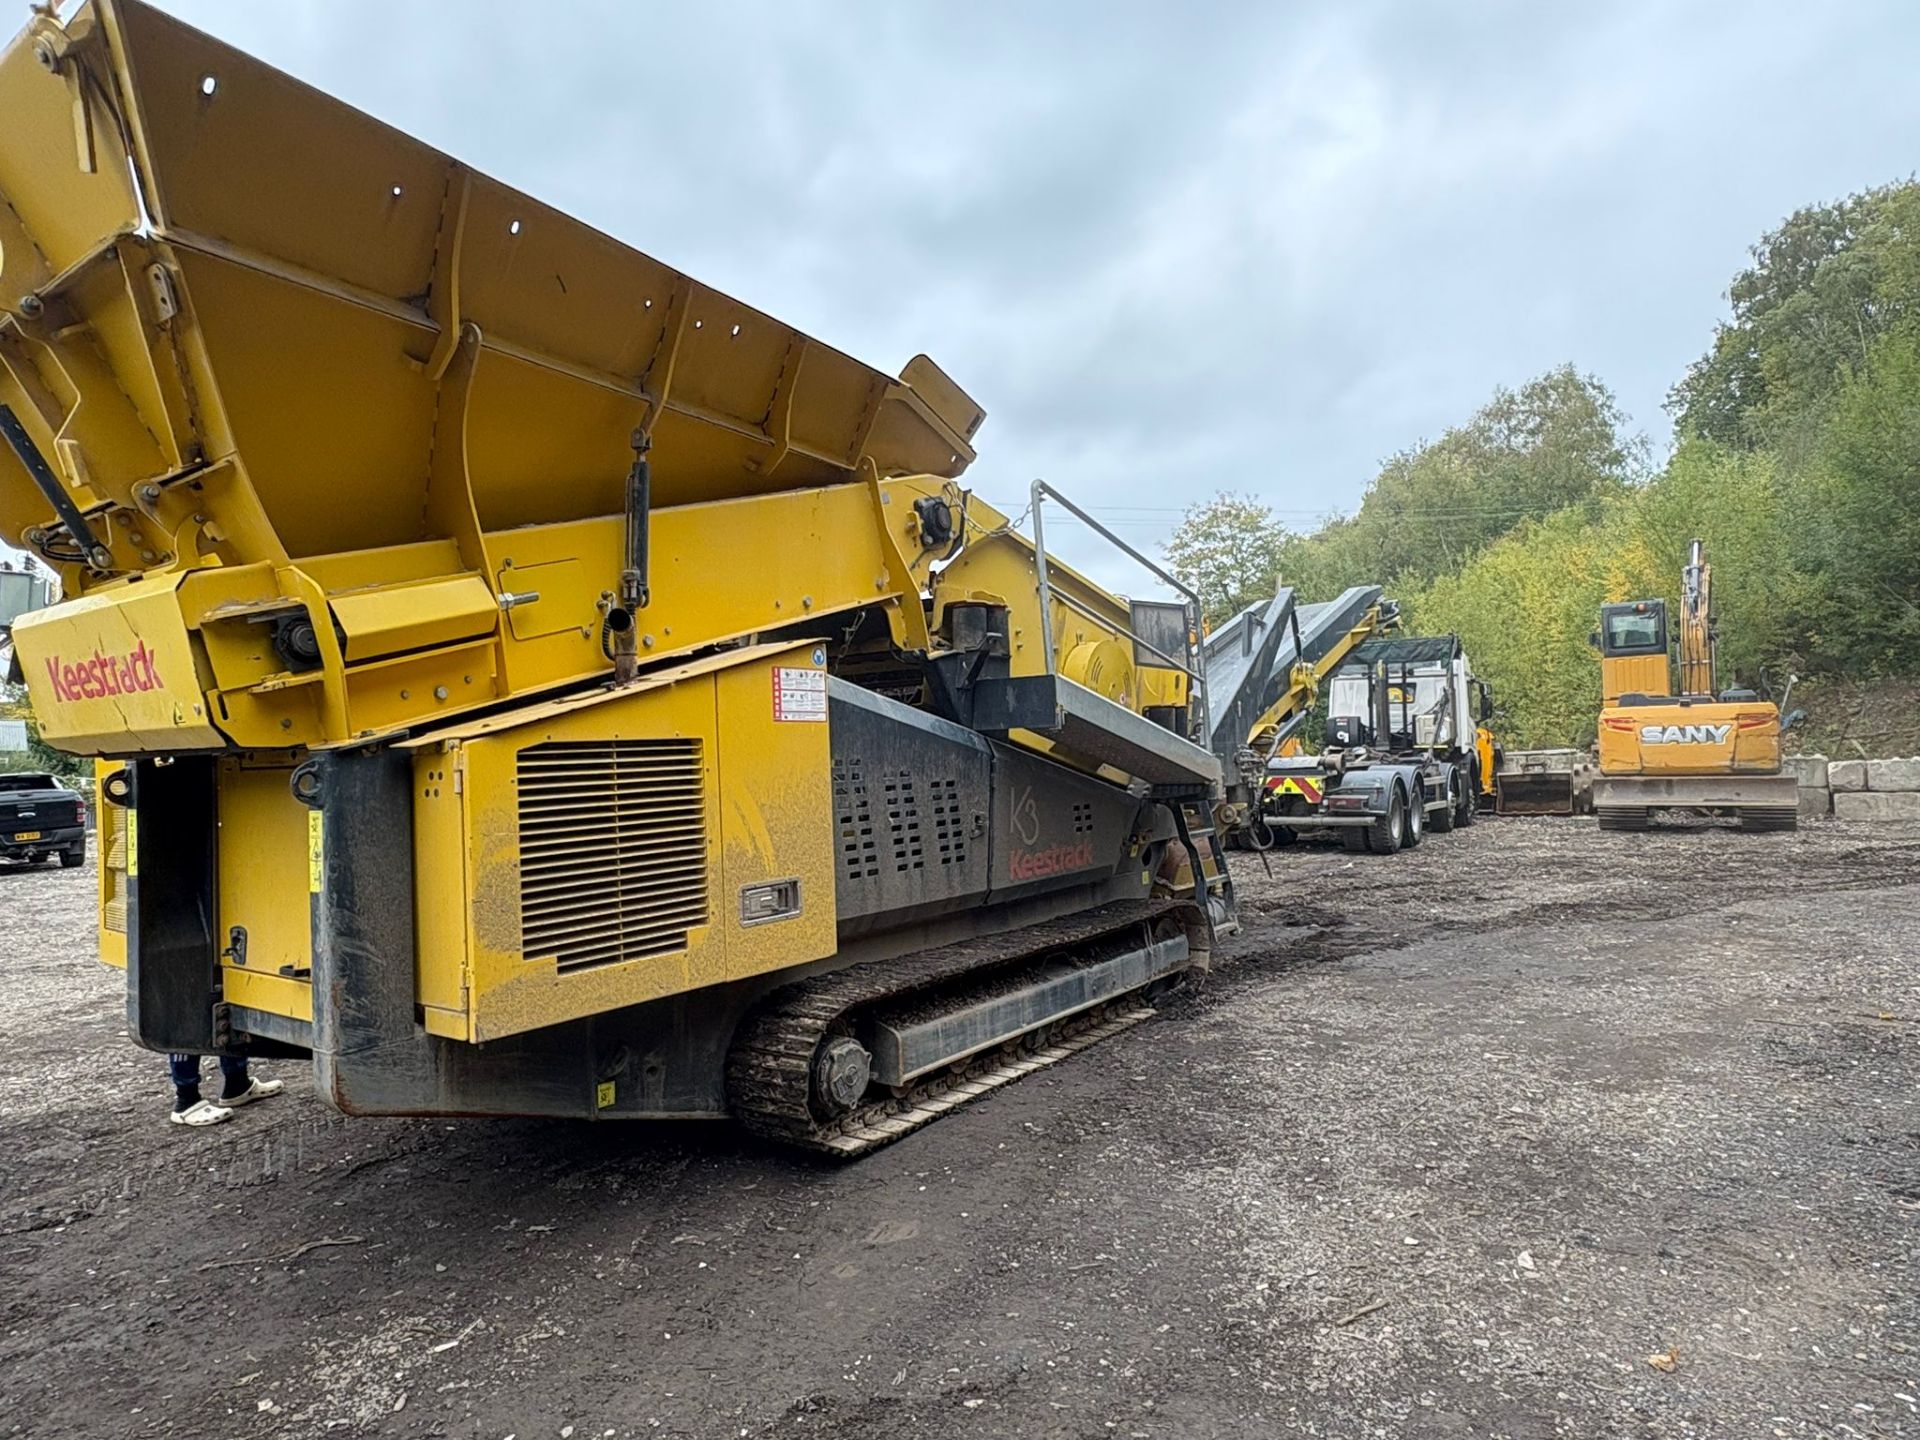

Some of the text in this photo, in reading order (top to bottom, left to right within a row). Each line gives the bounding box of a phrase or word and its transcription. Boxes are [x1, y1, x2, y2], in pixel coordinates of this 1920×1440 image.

[45, 639, 163, 703] Keestrack
[1641, 725, 1732, 745] SANY
[1010, 785, 1039, 845] K3
[1008, 839, 1095, 881] Keestrack
